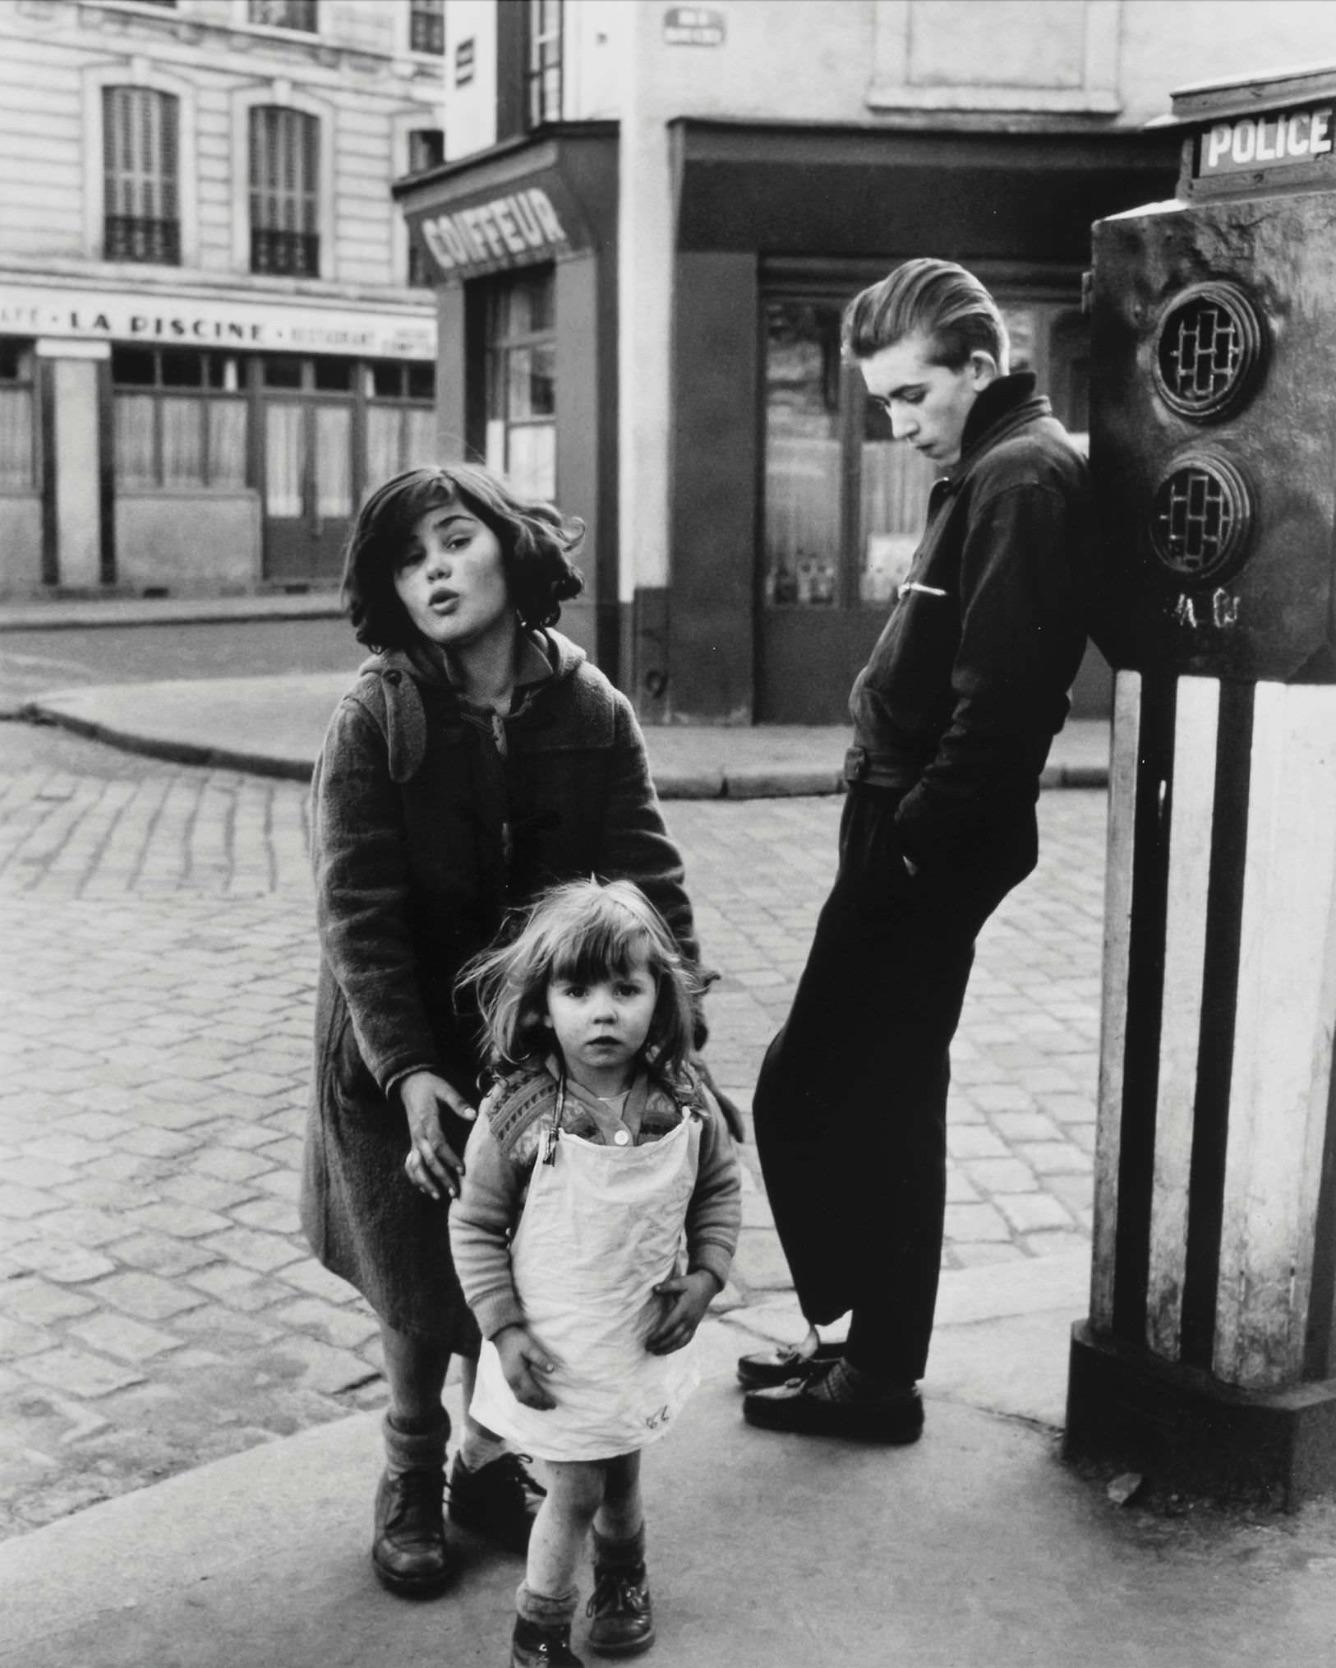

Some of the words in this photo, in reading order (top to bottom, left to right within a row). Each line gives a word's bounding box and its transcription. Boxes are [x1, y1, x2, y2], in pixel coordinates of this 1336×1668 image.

[1208, 108, 1333, 167] POLICE
[422, 187, 567, 269] COIFFEUR
[70, 310, 110, 331] LA
[131, 315, 262, 341] PISCINE
